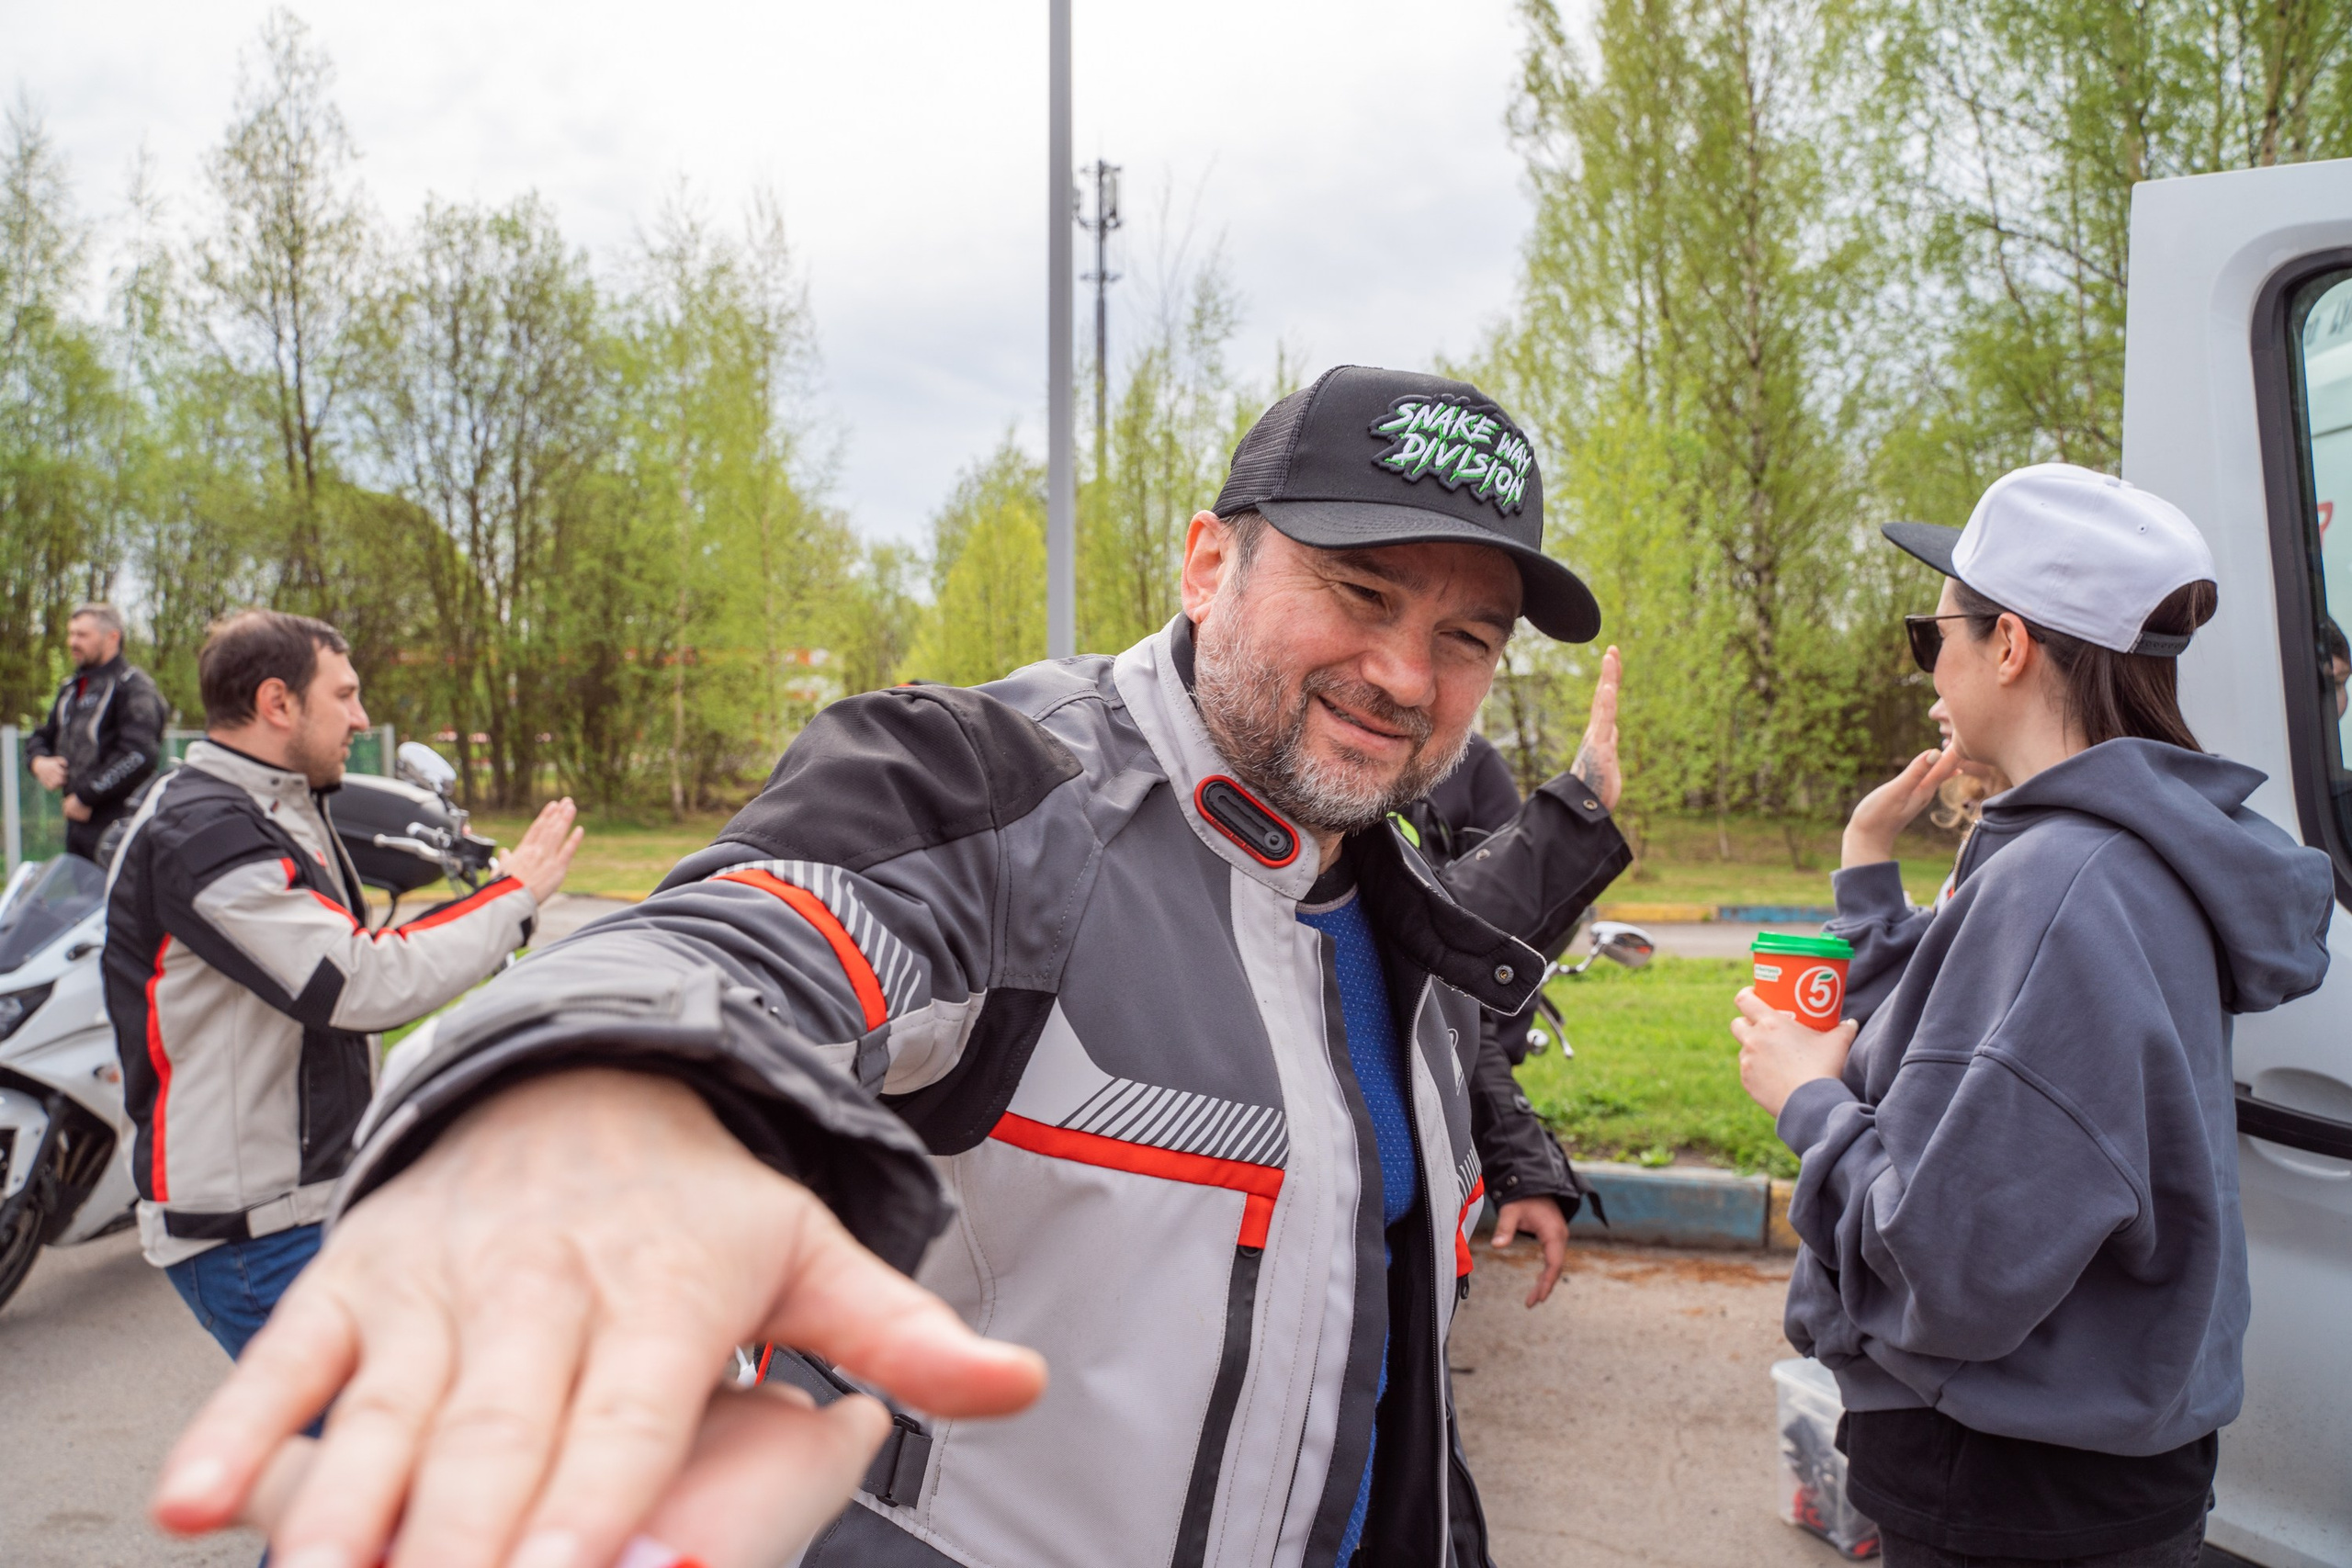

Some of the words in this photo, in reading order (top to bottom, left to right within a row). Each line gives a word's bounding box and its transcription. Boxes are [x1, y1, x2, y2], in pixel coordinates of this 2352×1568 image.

[1378, 401, 1501, 444] SNAKE
[1494, 432, 1532, 478] WAY
[1384, 433, 1526, 506] DIVISION
[1807, 971, 1835, 1009] 5
